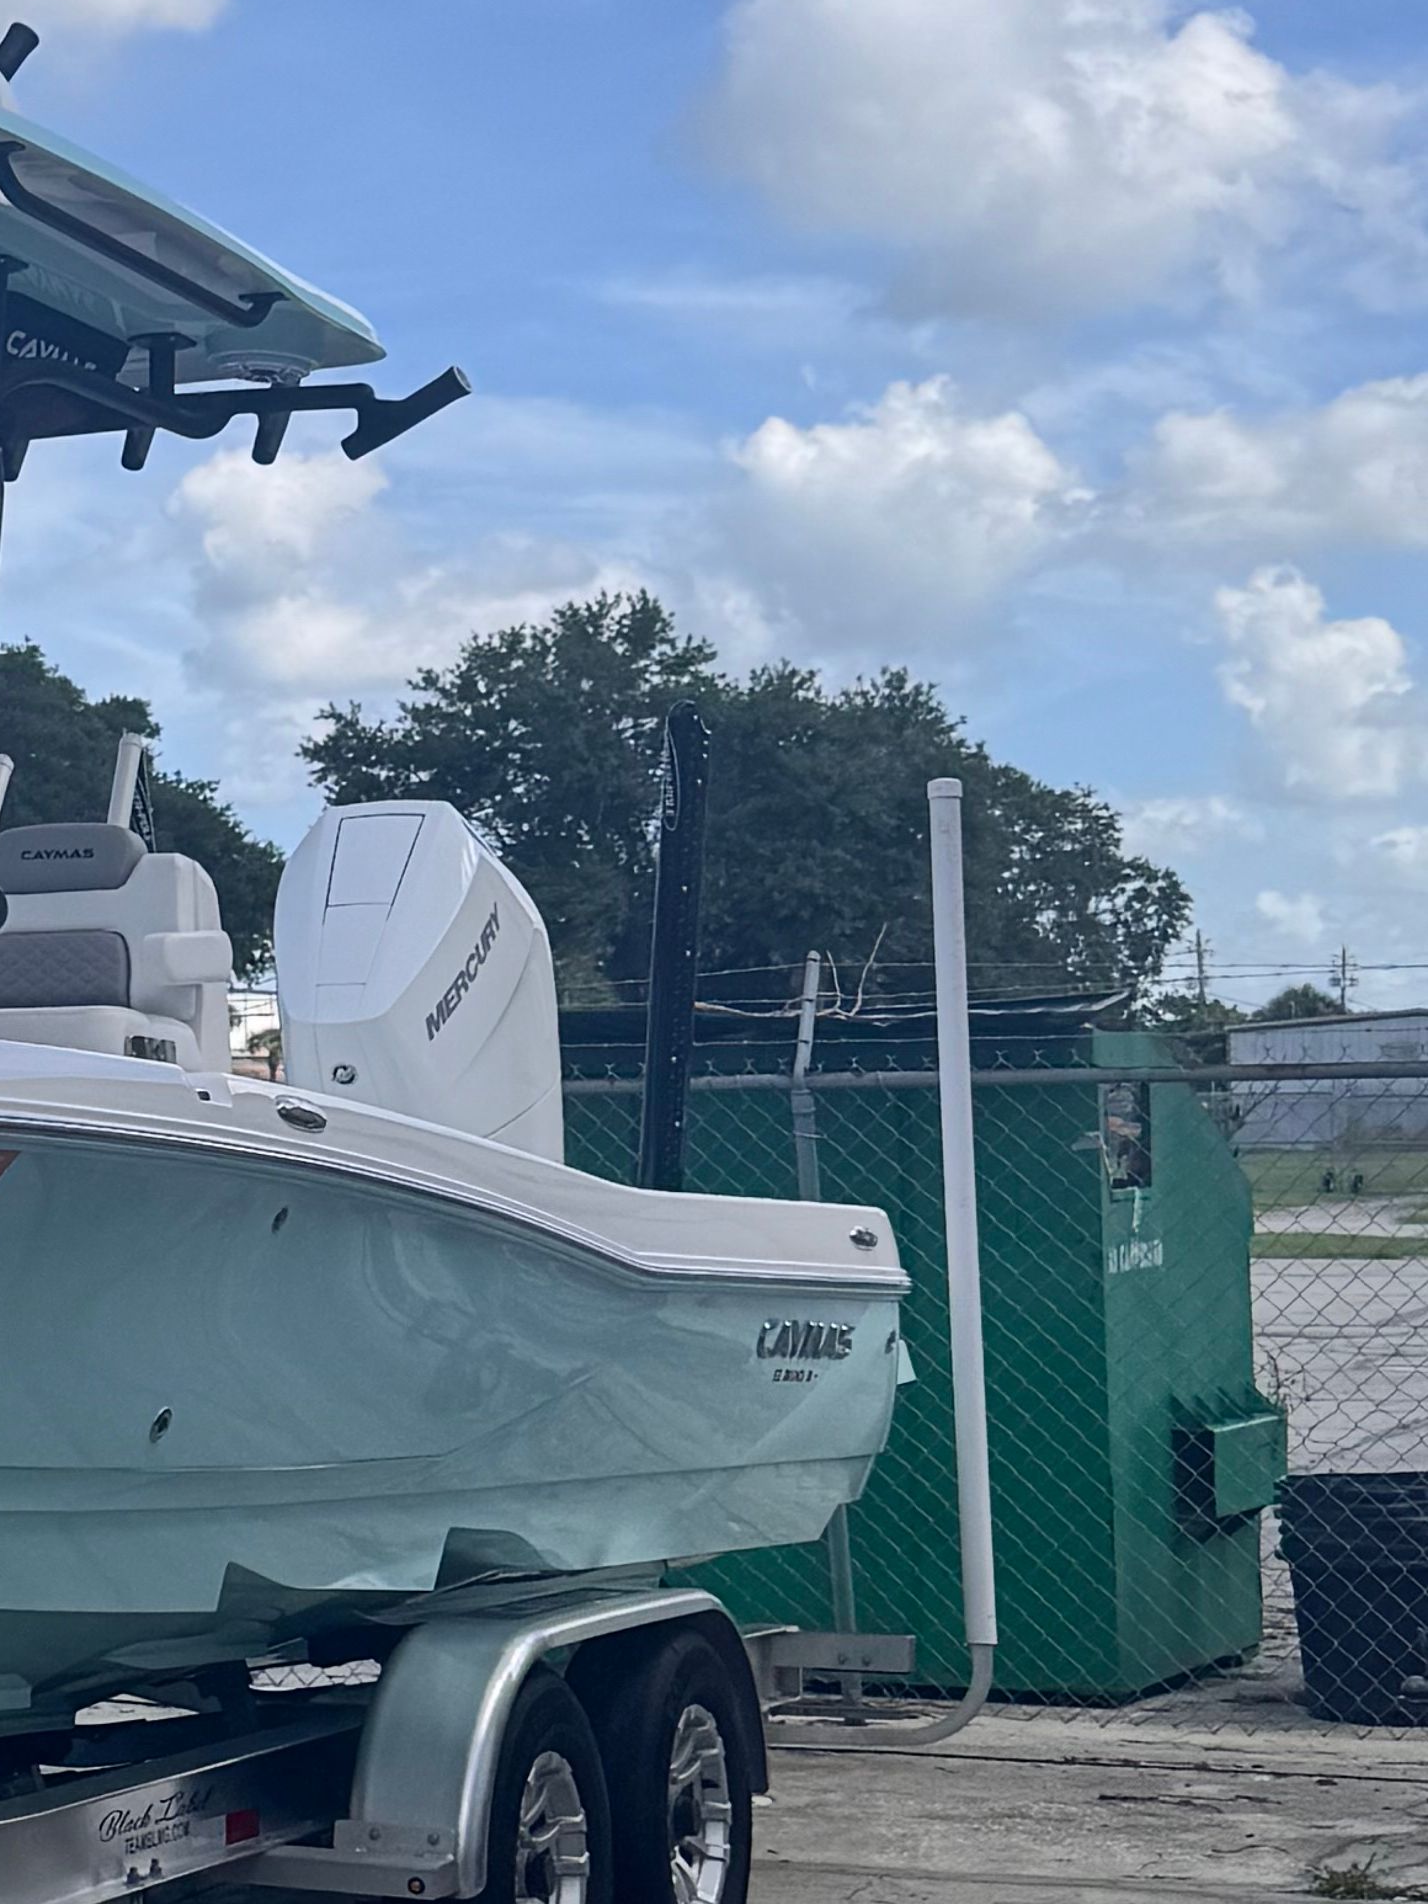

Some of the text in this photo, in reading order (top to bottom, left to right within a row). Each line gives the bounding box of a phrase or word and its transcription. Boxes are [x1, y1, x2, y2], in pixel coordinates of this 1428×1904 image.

[20, 848, 95, 861] CAYMAS
[425, 901, 501, 1042] MERCURY
[98, 1803, 154, 1843] Black
